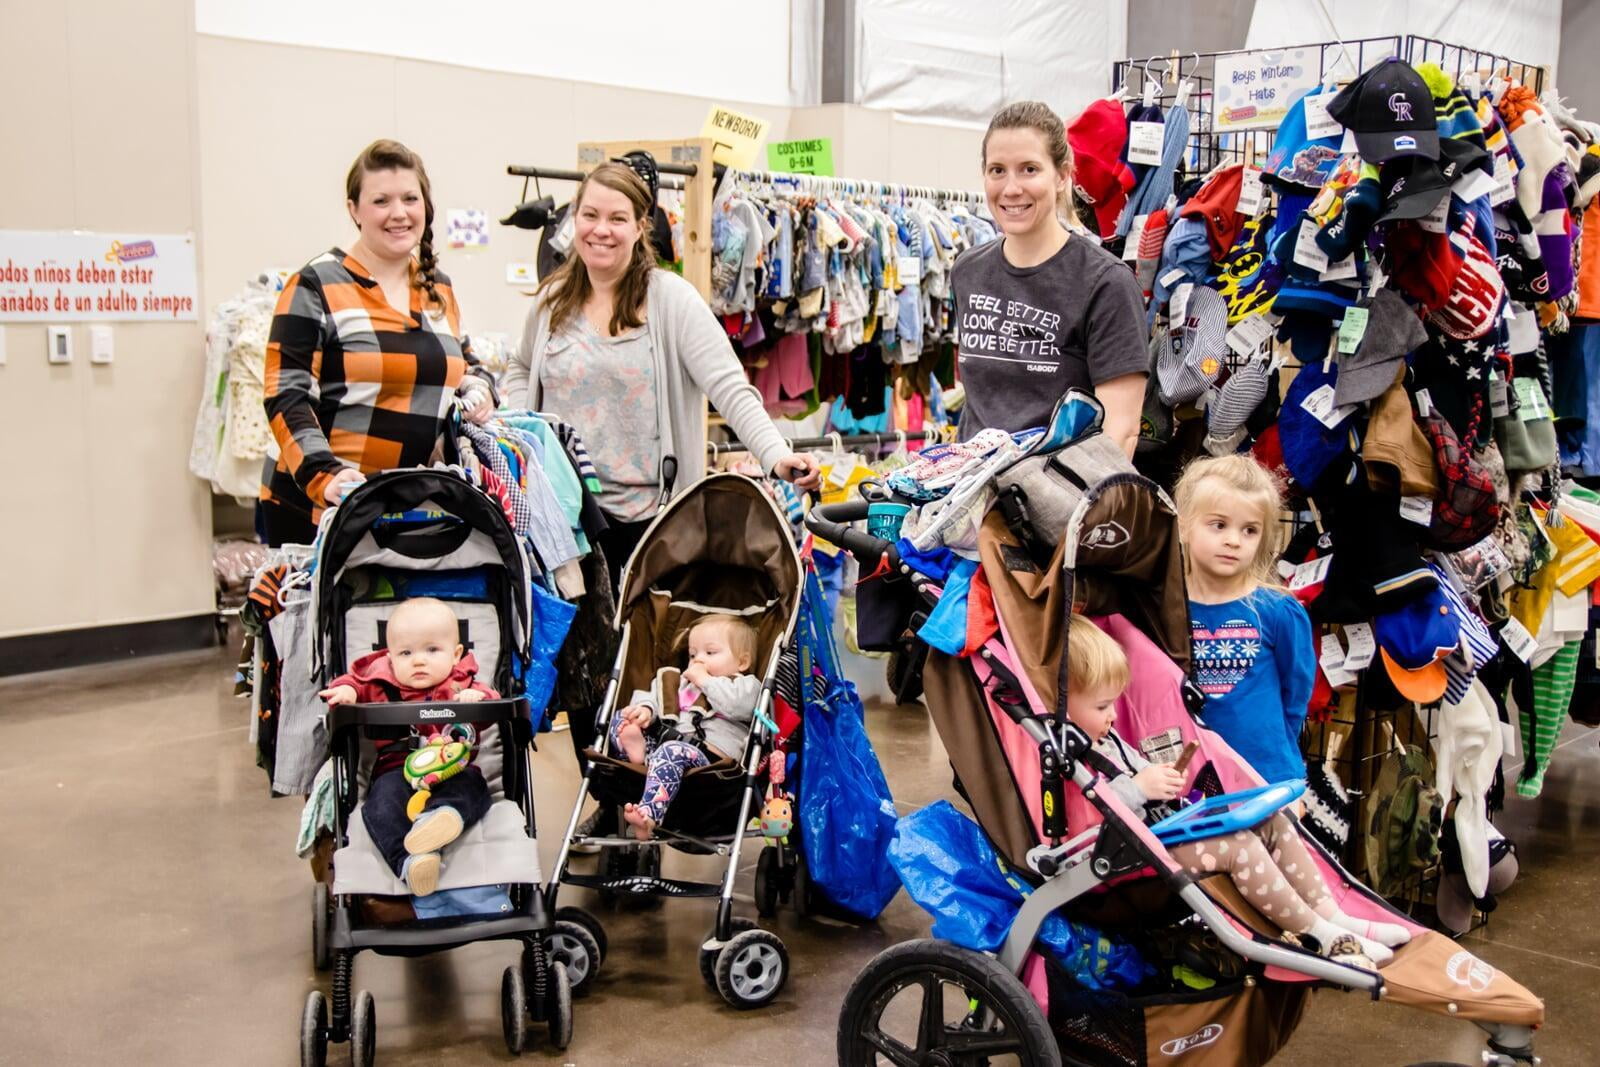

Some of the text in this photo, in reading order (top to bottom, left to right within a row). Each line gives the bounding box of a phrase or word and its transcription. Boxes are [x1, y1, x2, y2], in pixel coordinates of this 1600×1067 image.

[1232, 65, 1294, 85] Boys Winter
[1249, 87, 1276, 101] Hats
[712, 110, 762, 140] NEWBORN
[777, 139, 823, 155] COSTUMES
[76, 259, 116, 283] deben
[121, 264, 153, 284] estar
[54, 288, 69, 312] de
[75, 296, 92, 312] un
[97, 288, 137, 312] adulto
[143, 290, 193, 317] siempre
[968, 293, 1061, 331] FEEL BETTER
[963, 312, 999, 332] LOOK
